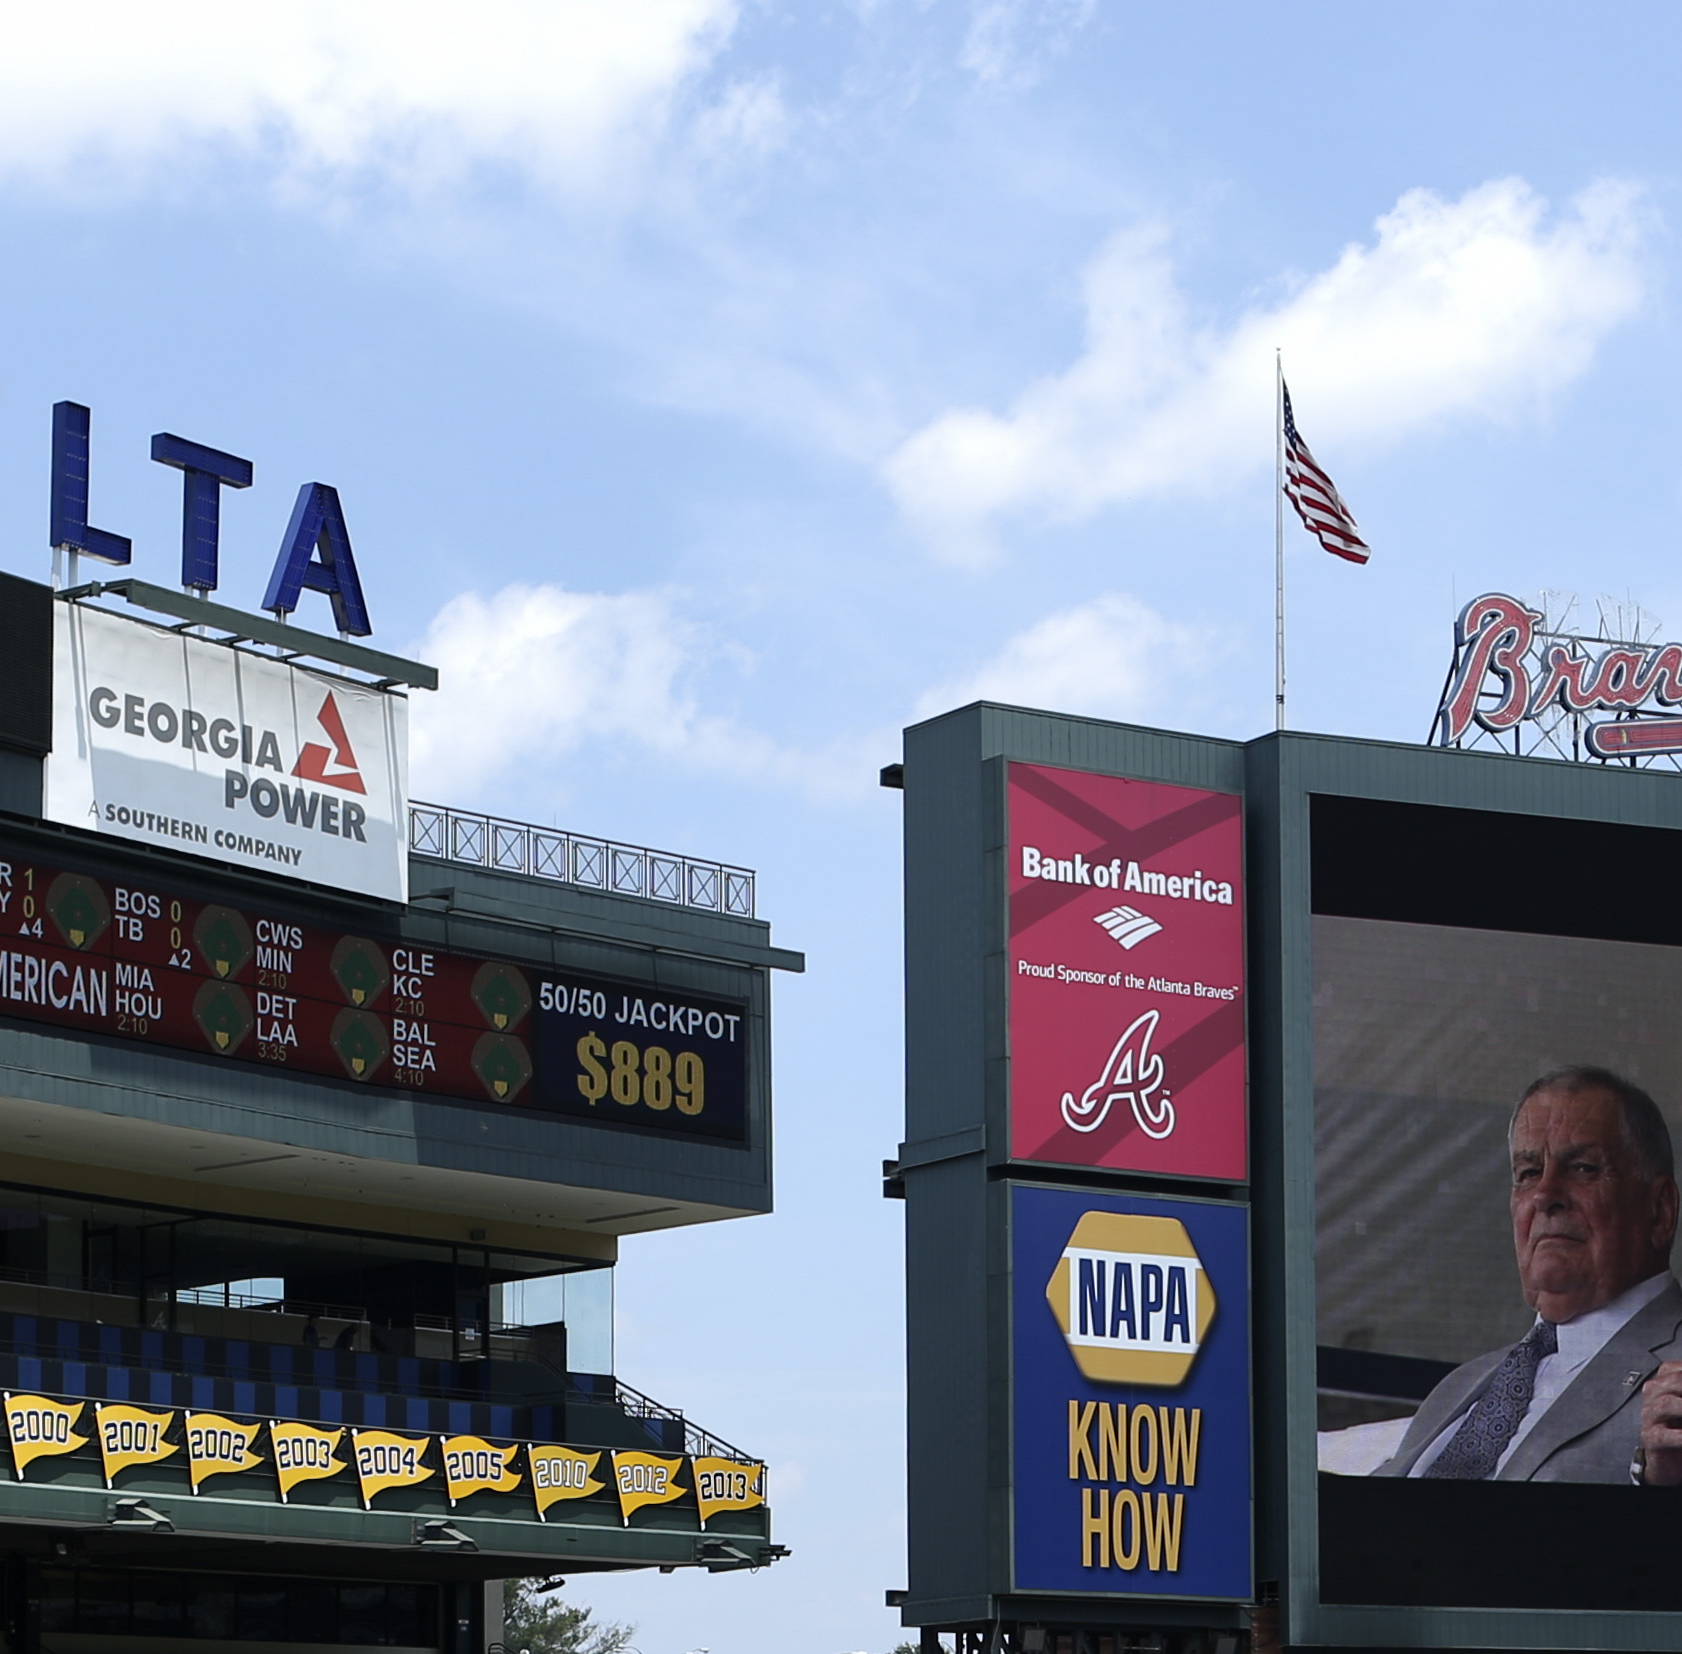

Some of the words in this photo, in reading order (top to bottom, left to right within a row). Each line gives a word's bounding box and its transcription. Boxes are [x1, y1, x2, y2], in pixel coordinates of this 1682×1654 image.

[89, 686, 284, 773] GEORGIA
[224, 769, 367, 843] POWER
[87, 799, 101, 818] A
[105, 803, 208, 844] SOUTHERN
[214, 830, 302, 867] COMPANY
[24, 868, 33, 891] 1
[1022, 846, 1091, 887] Bank
[1093, 858, 1123, 890] of
[1123, 861, 1233, 905] America
[23, 895, 35, 918] 0
[115, 888, 160, 918] BOS
[170, 901, 181, 923] 0
[32, 918, 43, 939] 4
[115, 915, 143, 942] TB
[170, 927, 181, 950] 0
[256, 919, 303, 950] CWS
[181, 949, 191, 970] 2
[256, 946, 292, 973] MIN
[392, 948, 434, 976] CLE
[115, 962, 154, 991] MIA
[258, 970, 286, 990] 2:10
[393, 974, 422, 999] KC
[1018, 960, 1054, 979] Proud
[1057, 964, 1106, 984] Sponsor
[1108, 972, 1122, 987] of
[1125, 974, 1145, 990] the
[1147, 977, 1190, 996] Atlanta
[115, 990, 162, 1020] HOU
[257, 992, 297, 1020] DET
[395, 998, 424, 1017] 2:10
[539, 982, 606, 1020] 50/50
[614, 996, 740, 1042] JACKPOT
[118, 1014, 147, 1035] 2:10
[257, 1017, 298, 1047] LAA
[393, 1019, 436, 1047] BAL
[258, 1043, 286, 1062] 3:35
[392, 1043, 436, 1072] SEA
[394, 1068, 424, 1087] 4:10
[576, 1031, 705, 1115] $889
[1078, 1257, 1191, 1344] NAPA
[10, 1410, 70, 1444] 2000
[104, 1421, 160, 1454] 2001
[189, 1429, 247, 1464] 2002
[277, 1437, 332, 1469] 2003
[1068, 1399, 1202, 1487] KNOW
[357, 1446, 416, 1477] 2004
[446, 1451, 505, 1482] 2005
[534, 1458, 588, 1489] 2010
[617, 1464, 668, 1495] 2012
[699, 1471, 747, 1503] 2013
[1082, 1488, 1184, 1572] HOW
